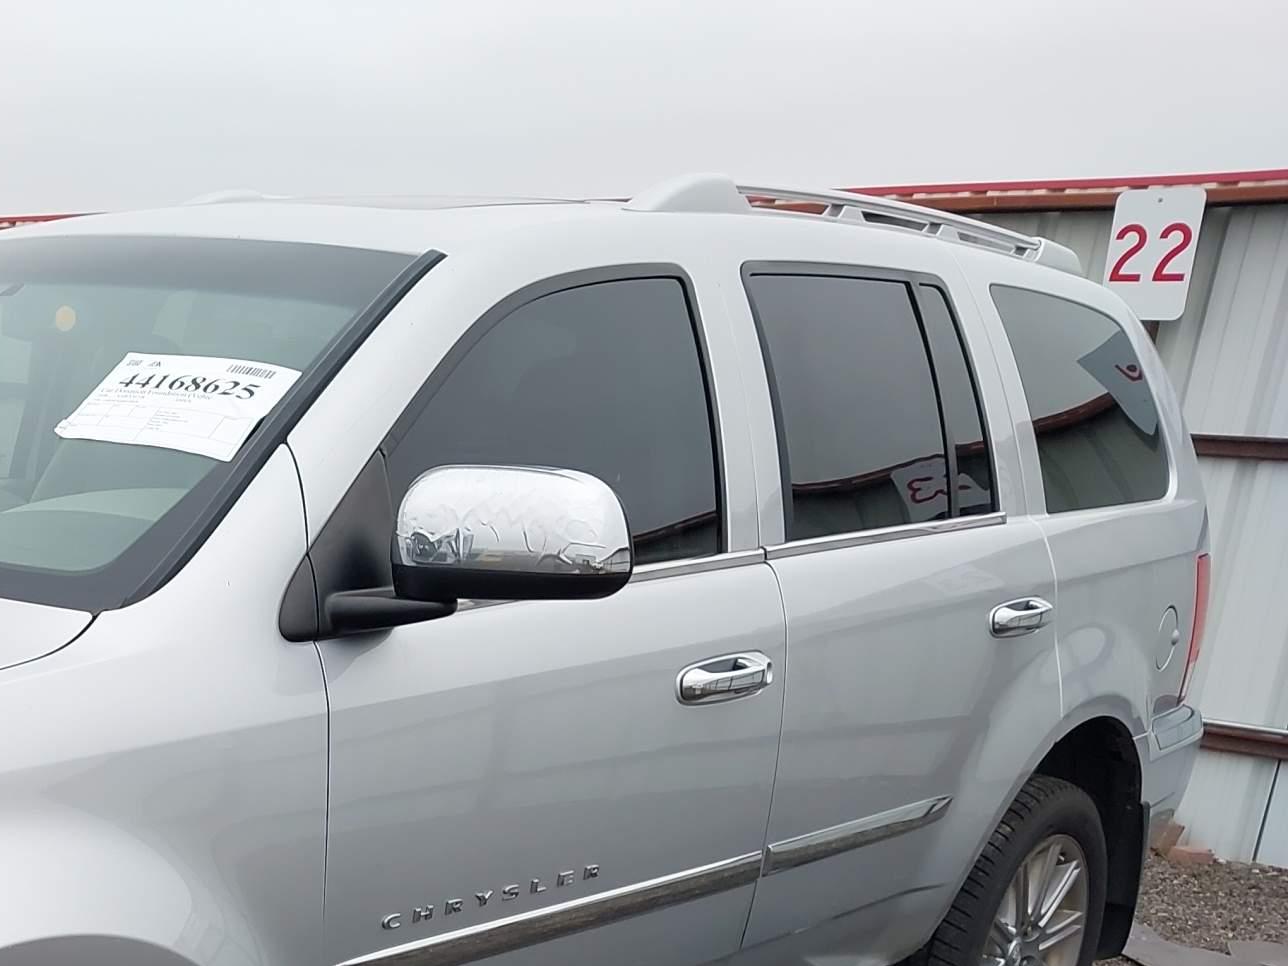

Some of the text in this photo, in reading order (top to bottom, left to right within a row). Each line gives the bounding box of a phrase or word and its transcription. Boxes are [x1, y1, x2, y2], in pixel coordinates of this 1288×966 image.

[1108, 222, 1193, 282] 22
[118, 372, 262, 400] 44168625
[380, 863, 600, 931] CHRYSLER
